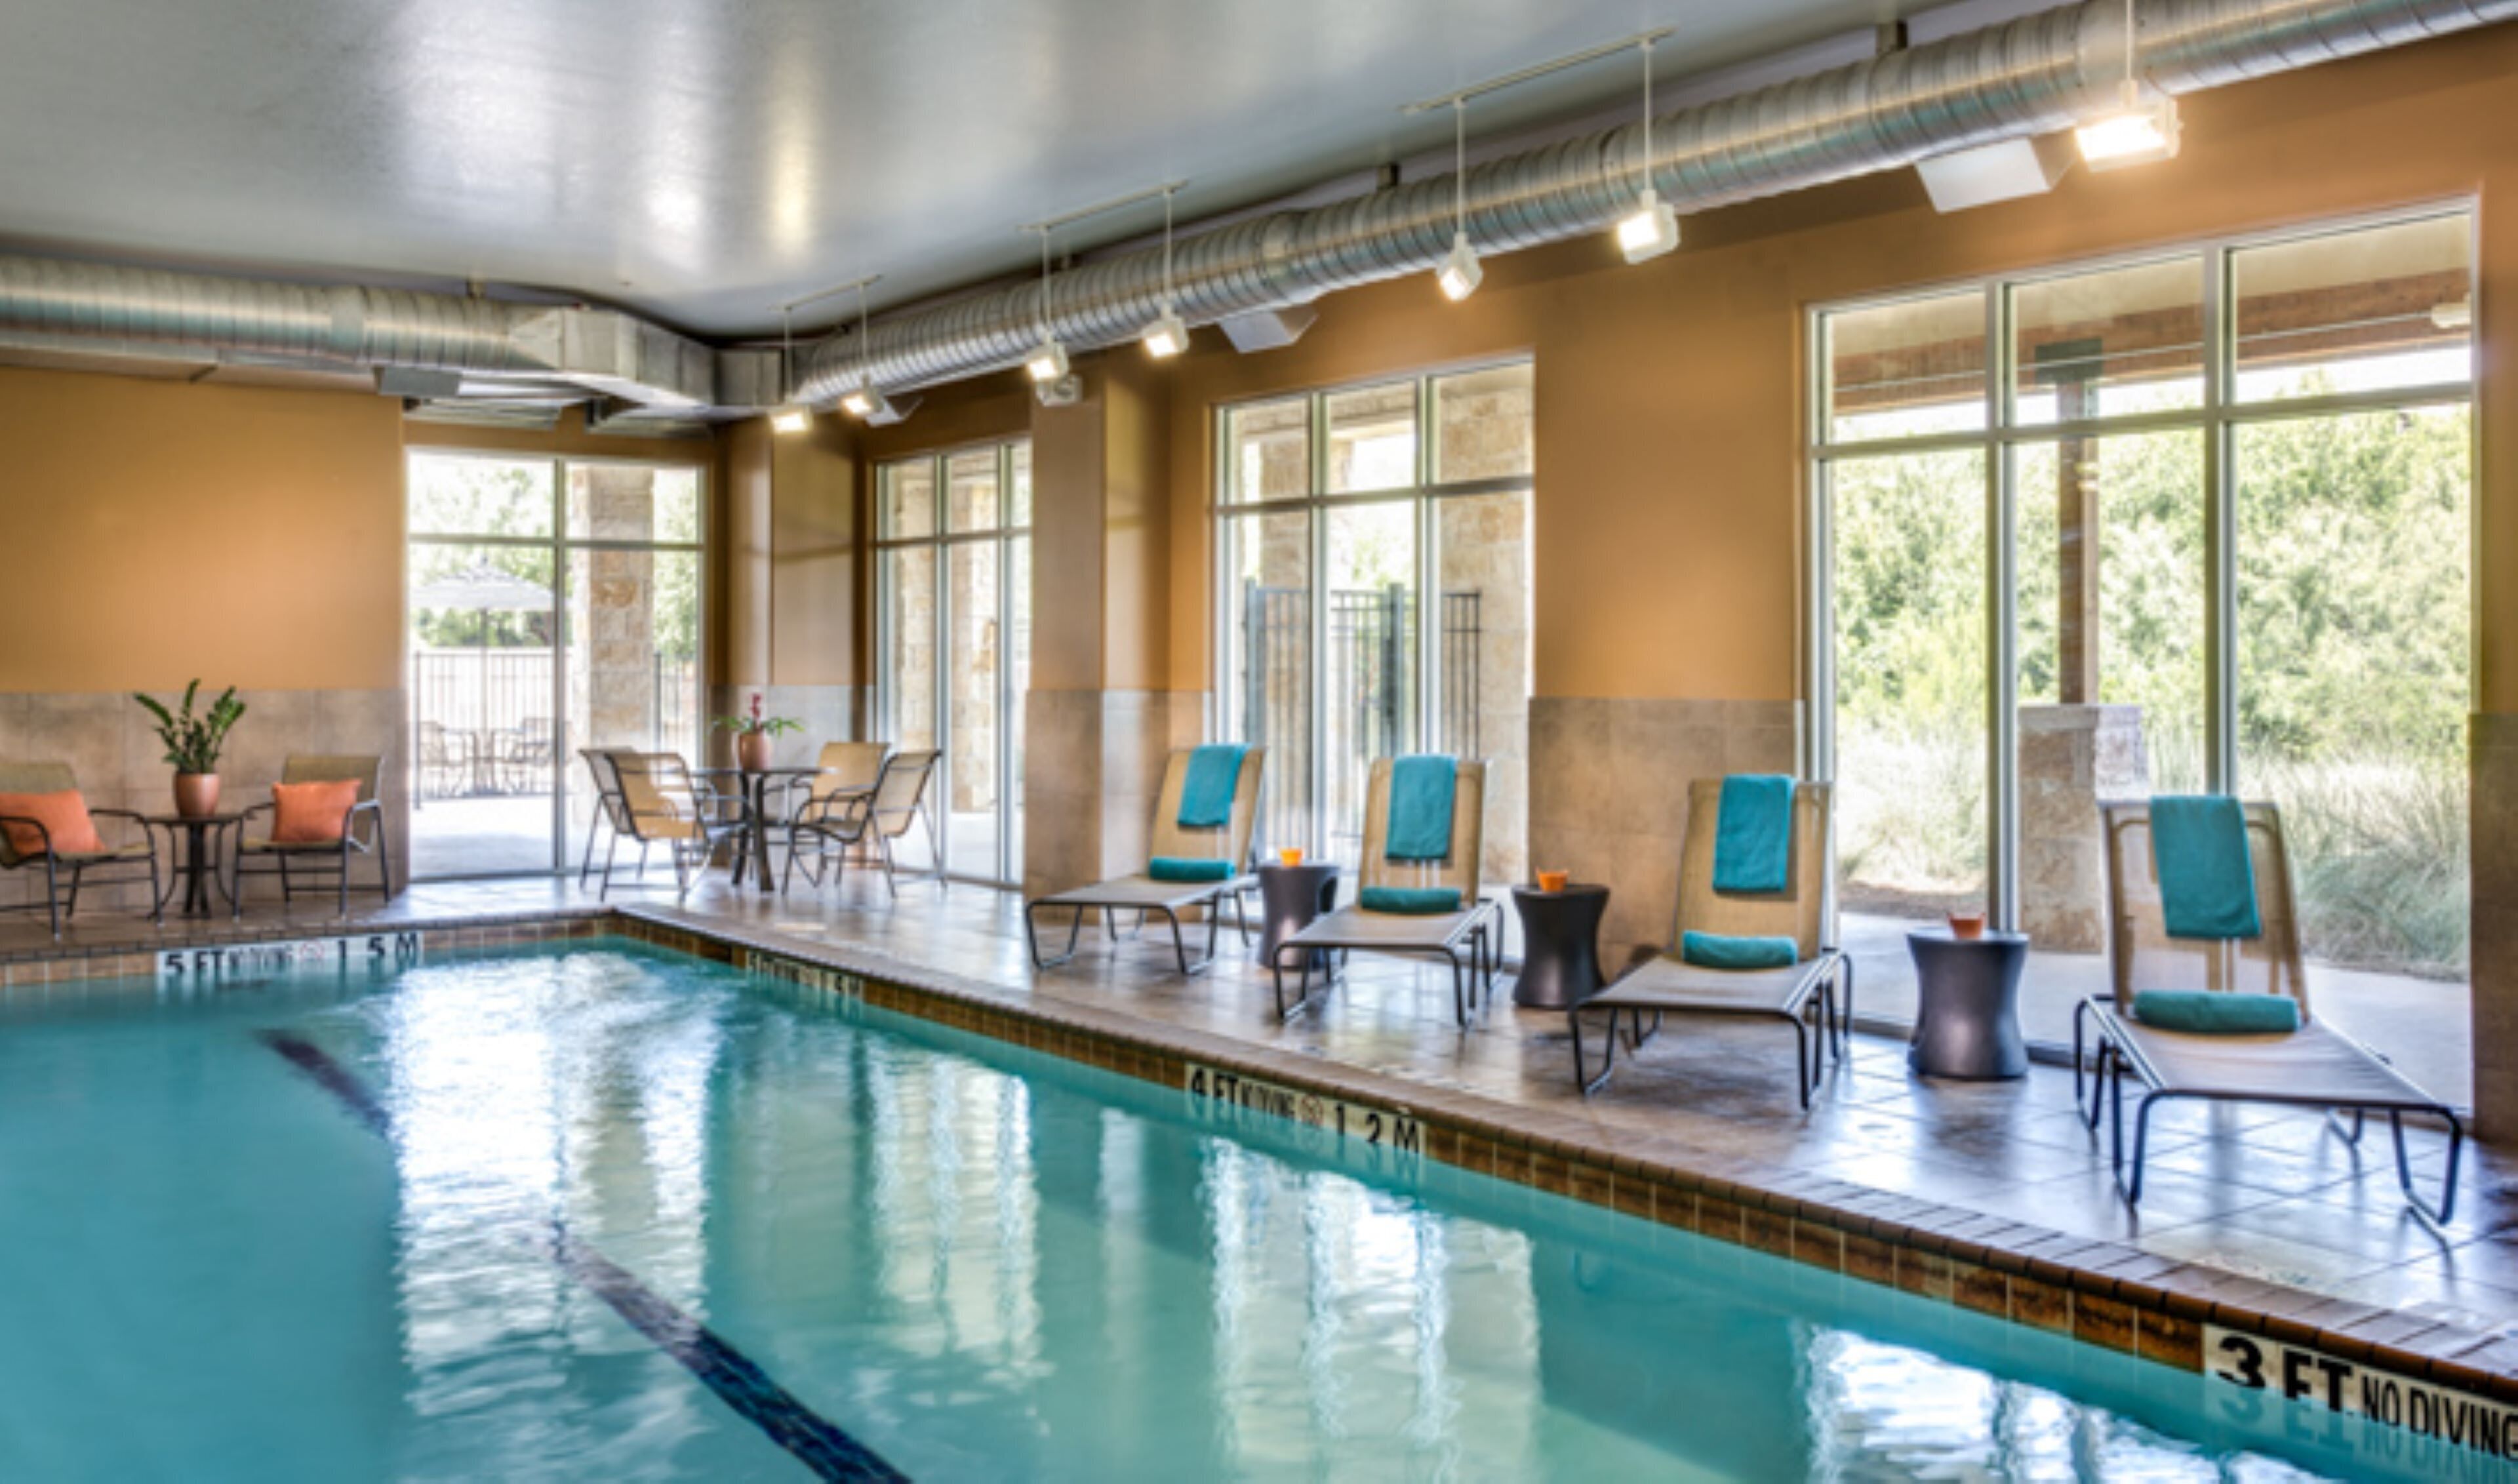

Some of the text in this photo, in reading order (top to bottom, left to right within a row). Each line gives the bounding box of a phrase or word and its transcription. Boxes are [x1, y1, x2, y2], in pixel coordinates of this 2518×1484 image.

[166, 953, 185, 973] 5
[196, 949, 225, 971] FT
[1191, 1068, 1207, 1097] 4
[1213, 1071, 1239, 1104] FT
[1393, 1117, 1419, 1153] M
[2216, 1335, 2266, 1388] 3
[2362, 1374, 2400, 1428] NO
[2409, 1386, 2518, 1462] DIVING
